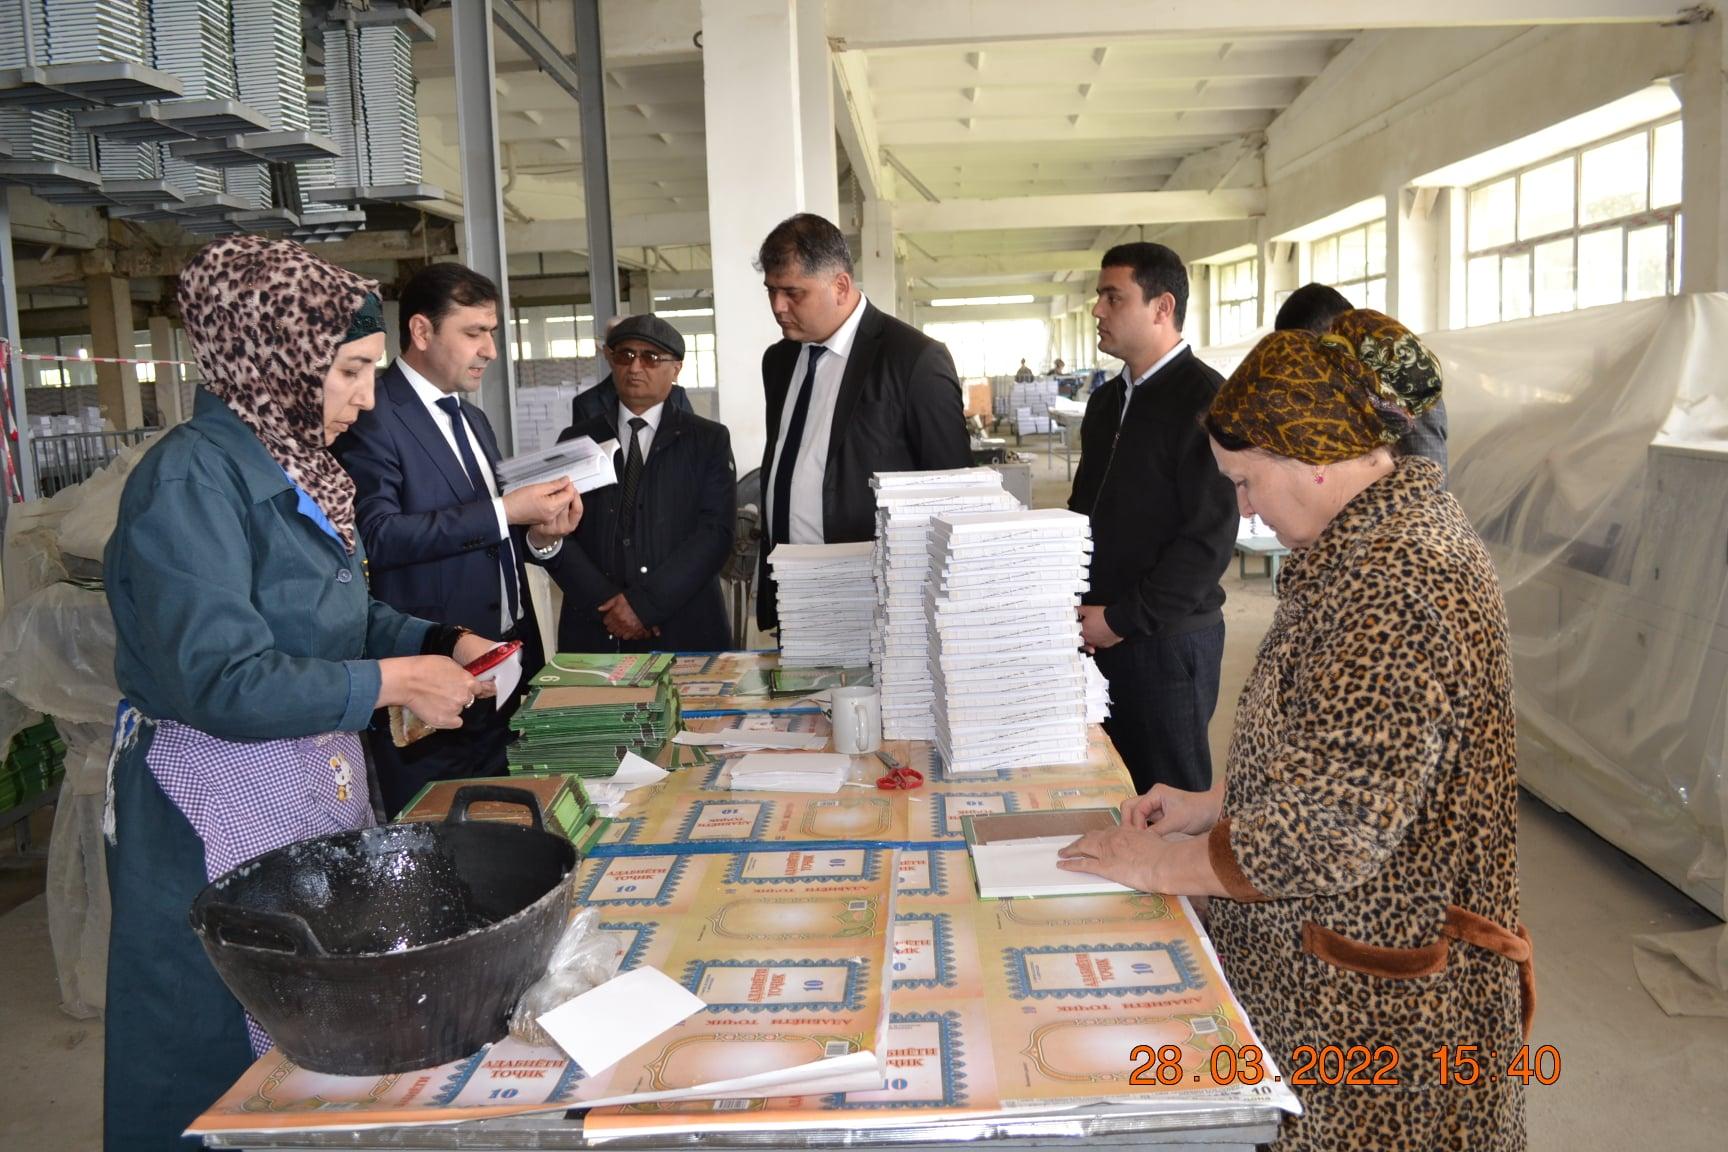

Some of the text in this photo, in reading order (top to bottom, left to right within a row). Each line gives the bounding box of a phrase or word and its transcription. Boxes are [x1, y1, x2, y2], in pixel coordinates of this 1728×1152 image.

[616, 885, 637, 893] 10
[1131, 963, 1154, 975] 10
[803, 979, 824, 992] 10
[487, 1087, 520, 1099] 10
